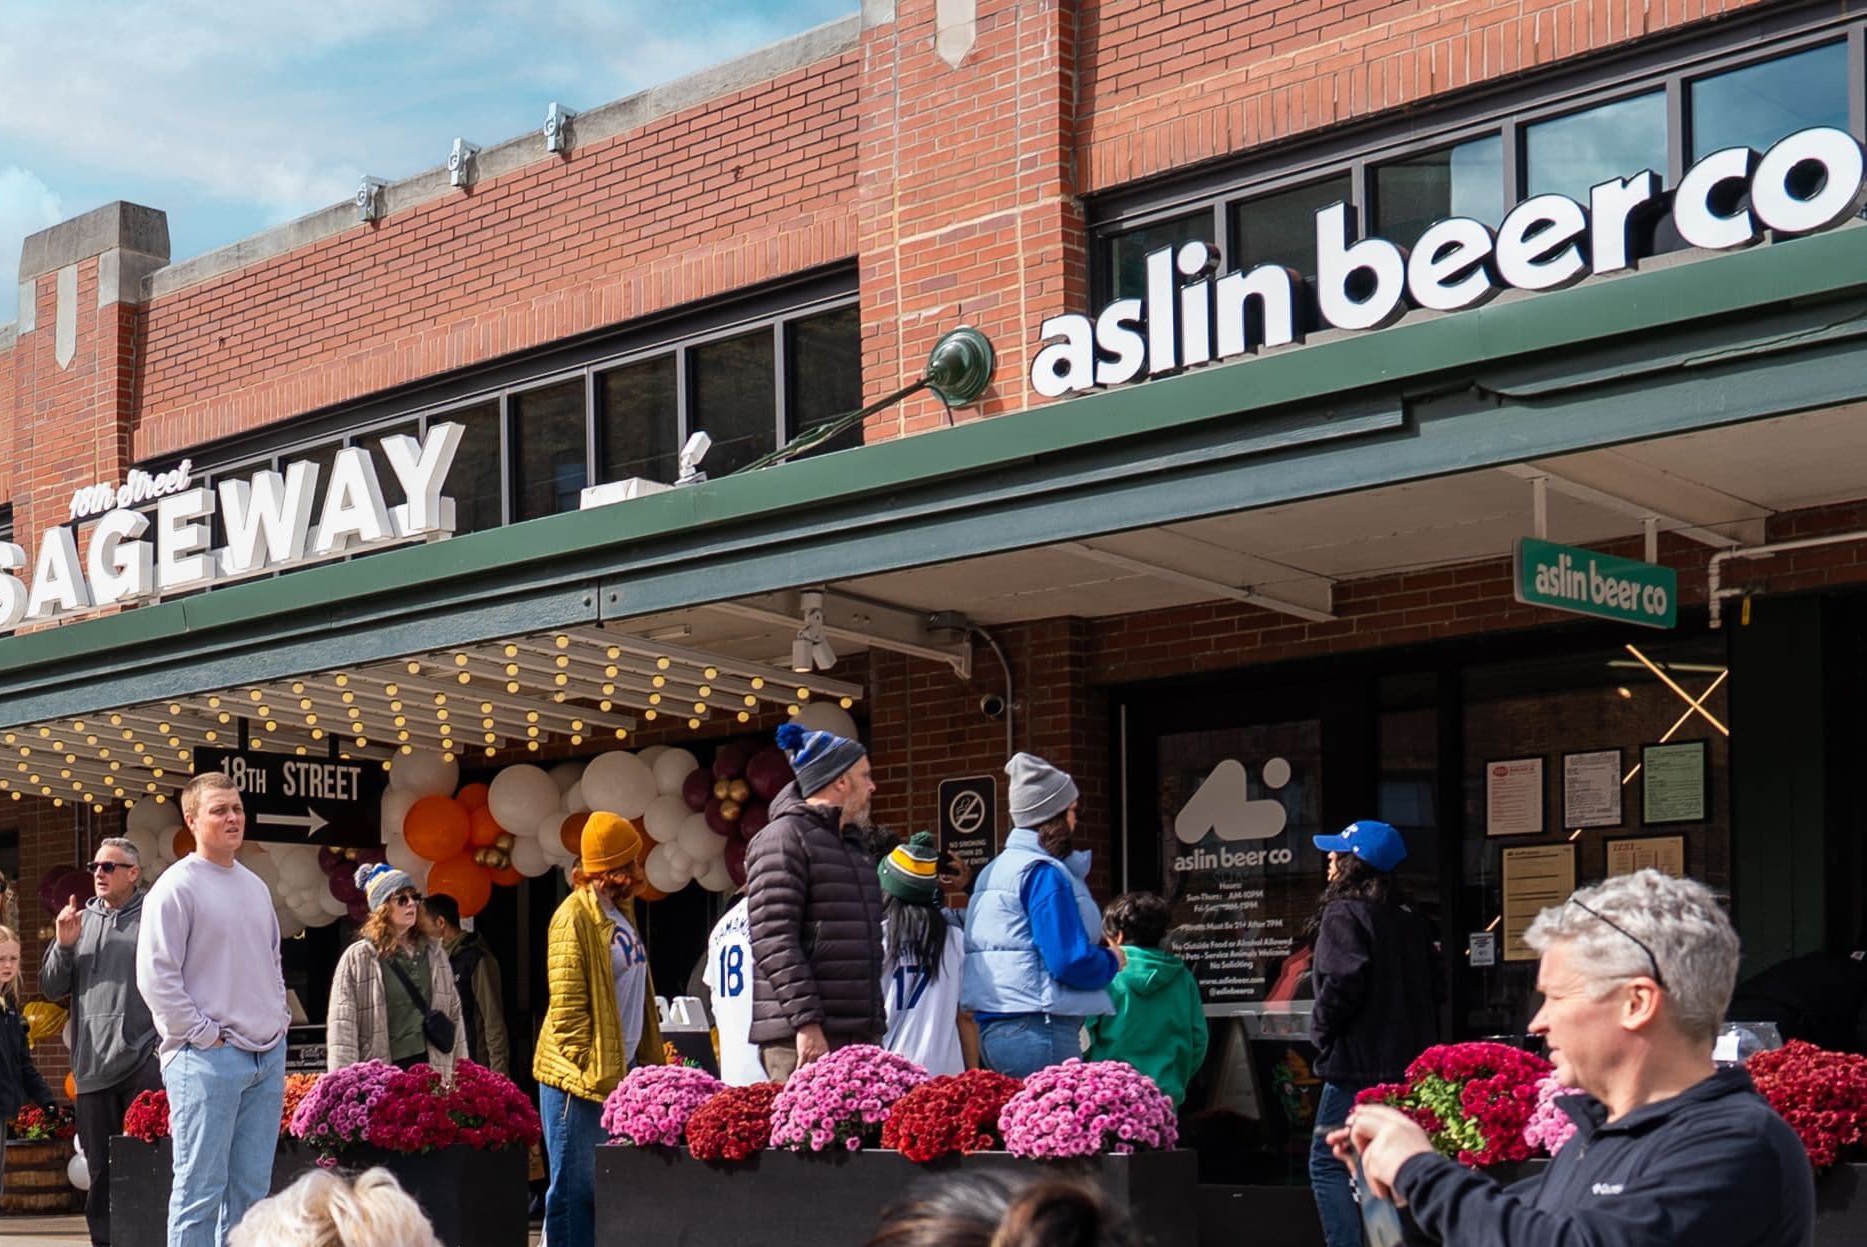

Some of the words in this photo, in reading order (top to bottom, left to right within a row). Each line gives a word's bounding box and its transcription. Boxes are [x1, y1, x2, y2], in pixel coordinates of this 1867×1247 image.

[1030, 241, 1296, 398] aslin
[1316, 171, 1657, 331] beer
[1674, 126, 1866, 250] co
[117, 459, 192, 508] Street
[1535, 553, 1587, 601] aslin
[1589, 560, 1641, 611] beer
[1642, 584, 1667, 616] co
[220, 755, 266, 794] 18TH
[283, 761, 361, 800] STREET
[1174, 848, 1218, 871] aslin
[1220, 847, 1267, 868] beer
[1268, 848, 1292, 864] co
[719, 944, 744, 998] 18
[892, 965, 931, 1011] 17
